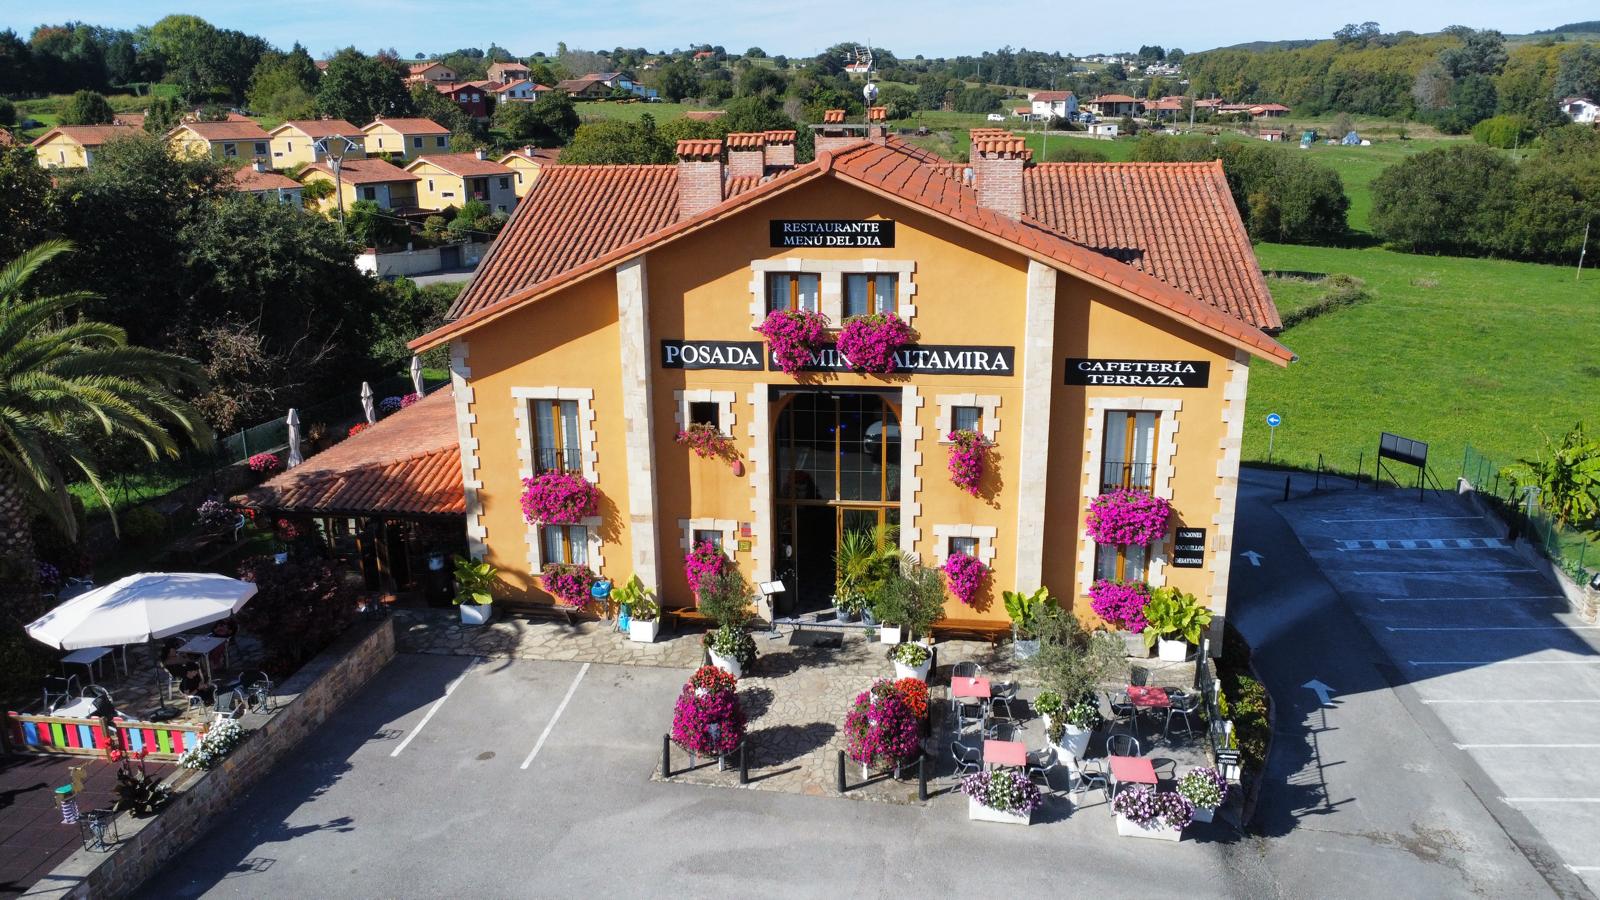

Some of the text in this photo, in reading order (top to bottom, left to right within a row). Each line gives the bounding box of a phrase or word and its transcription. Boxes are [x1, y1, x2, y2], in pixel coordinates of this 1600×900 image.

[783, 222, 880, 233] RESTAURANTE
[783, 234, 882, 246] MENÚ DEL DIA
[664, 344, 760, 365] POSADA
[890, 350, 1010, 371] ALTAMIRA
[1077, 361, 1196, 373] CAFETERÍA
[1087, 374, 1185, 386] TERRAZA
